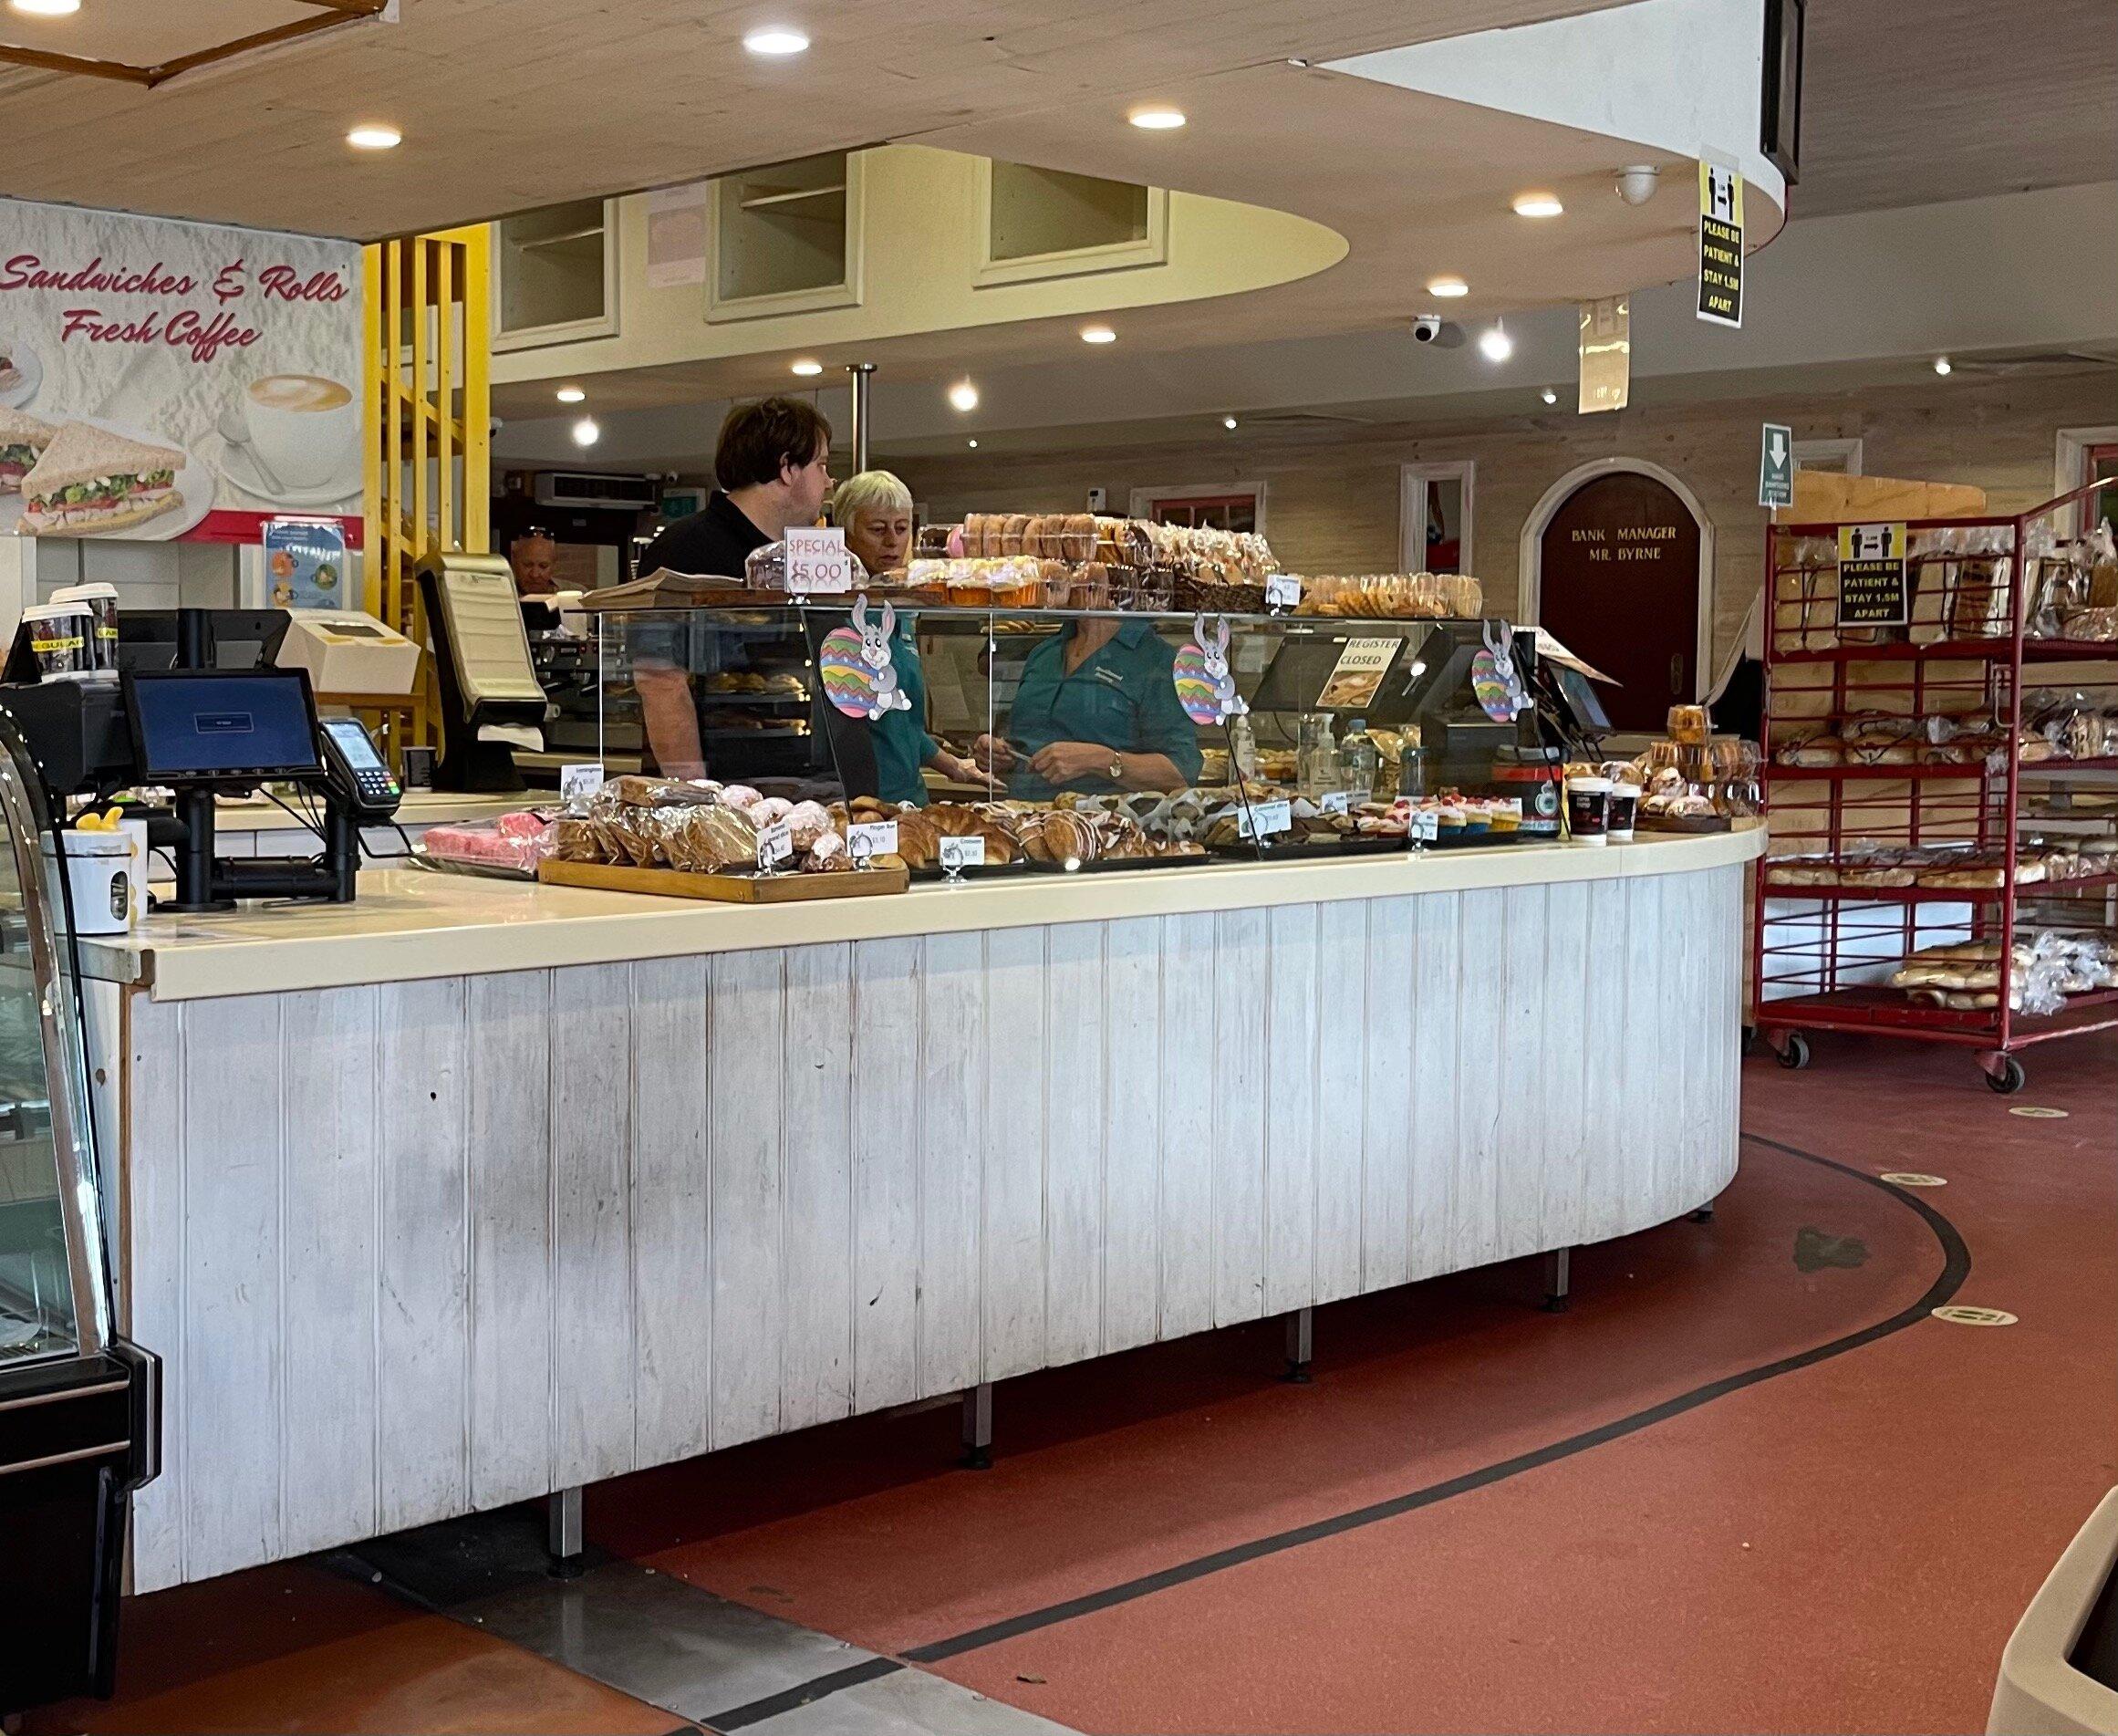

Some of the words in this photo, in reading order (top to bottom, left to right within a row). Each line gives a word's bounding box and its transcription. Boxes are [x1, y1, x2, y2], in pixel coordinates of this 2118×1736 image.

[1704, 220, 1729, 239] PLEASE
[1731, 230, 1739, 244] BE
[1704, 244, 1733, 265] PATIENT
[1734, 255, 1739, 267] &
[0, 255, 198, 296] Sandwiches
[213, 258, 245, 306] &
[259, 265, 349, 302] Rolls
[1704, 269, 1723, 286] STAY
[1708, 295, 1732, 313] APART
[61, 308, 163, 344] Fresh
[164, 309, 263, 363] Coffee
[1572, 529, 1605, 542] BANK
[1617, 526, 1677, 540] MANAGER
[789, 539, 845, 554] SPECIAL
[1589, 548, 1612, 561] MR.
[1617, 547, 1661, 561] BYRNE
[792, 560, 842, 584] $5.00
[1843, 562, 1883, 572] PLEASE
[1885, 562, 1899, 571] BE
[1843, 577, 1888, 587] PATIENT
[1891, 577, 1899, 587] &
[1844, 593, 1873, 603] STAY
[1875, 593, 1899, 603] 1.5M
[1854, 608, 1890, 619] APART
[1348, 640, 1400, 649] REGISTER
[1340, 656, 1382, 664] CLOSED
